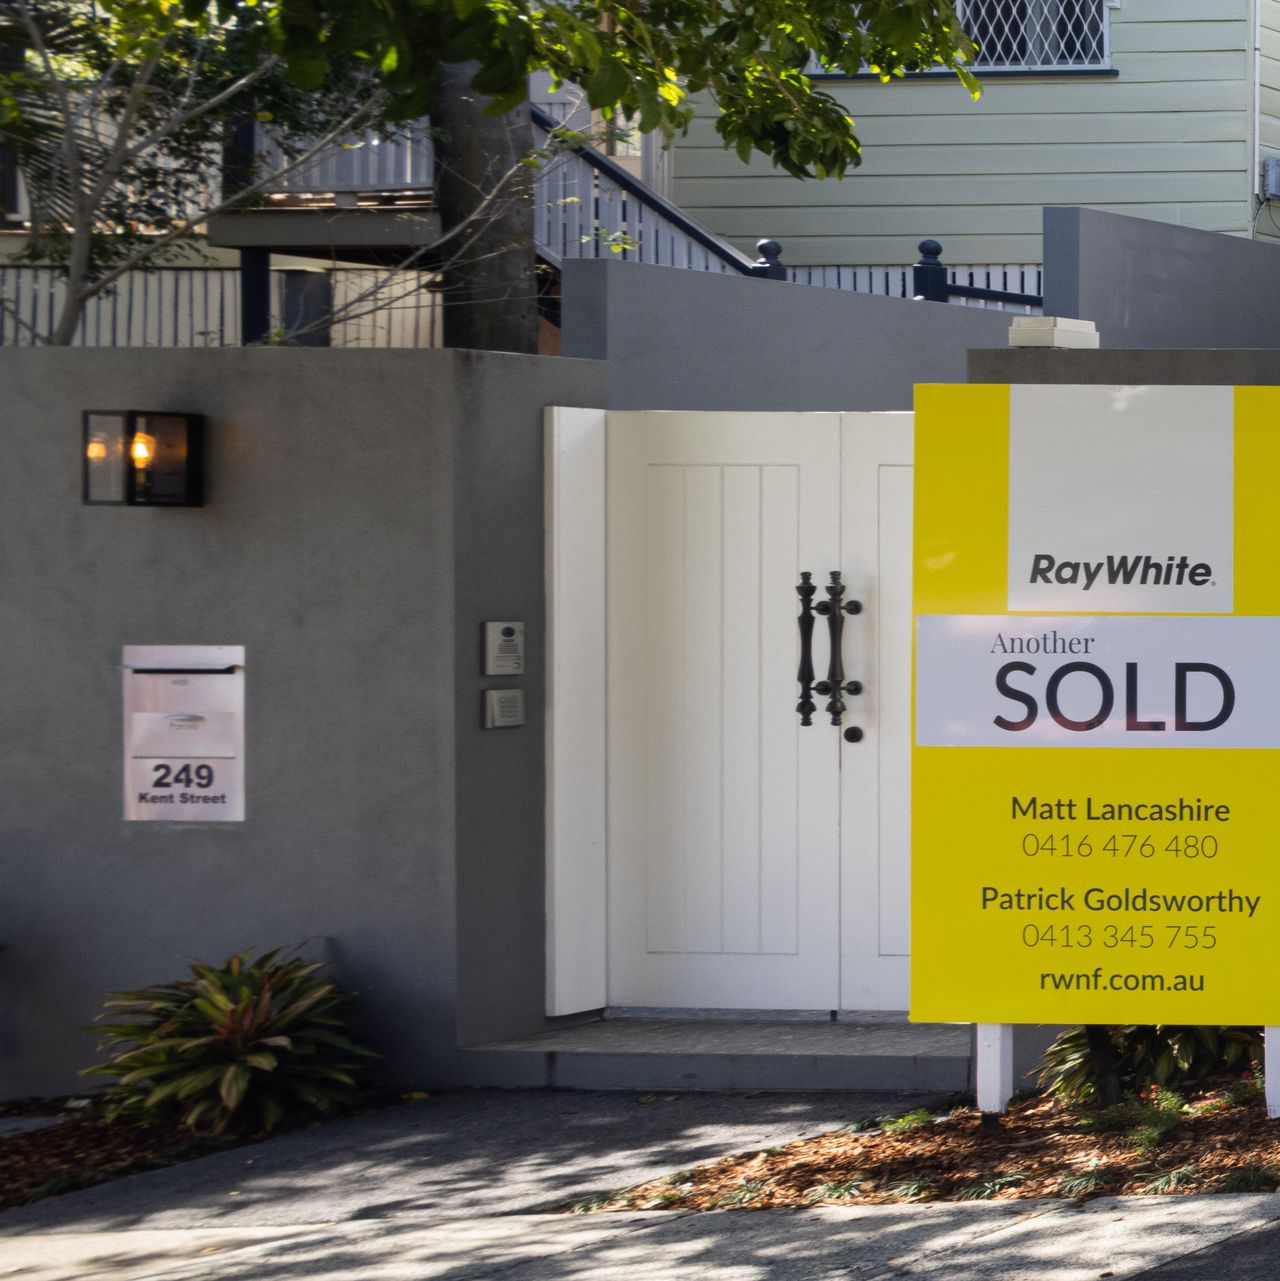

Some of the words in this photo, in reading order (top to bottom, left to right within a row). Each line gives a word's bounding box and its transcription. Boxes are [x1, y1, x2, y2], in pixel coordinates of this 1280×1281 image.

[990, 630, 1096, 655] Another
[992, 660, 1236, 732] SOLD
[152, 763, 214, 789] 249
[138, 792, 174, 804] Kent
[179, 792, 227, 804] Street
[1011, 796, 1077, 821] Matt
[1086, 797, 1231, 822] Lancashire
[1022, 833, 1093, 858] 0416
[1102, 834, 1156, 858] 476
[1164, 834, 1218, 859] 480
[982, 886, 1075, 911] Patrick
[1083, 887, 1261, 918] Goldsworthy
[1022, 923, 1093, 948] 0413
[1103, 924, 1154, 949] 345
[1165, 925, 1217, 950] 755
[1040, 967, 1205, 992] rwnf.com.au
